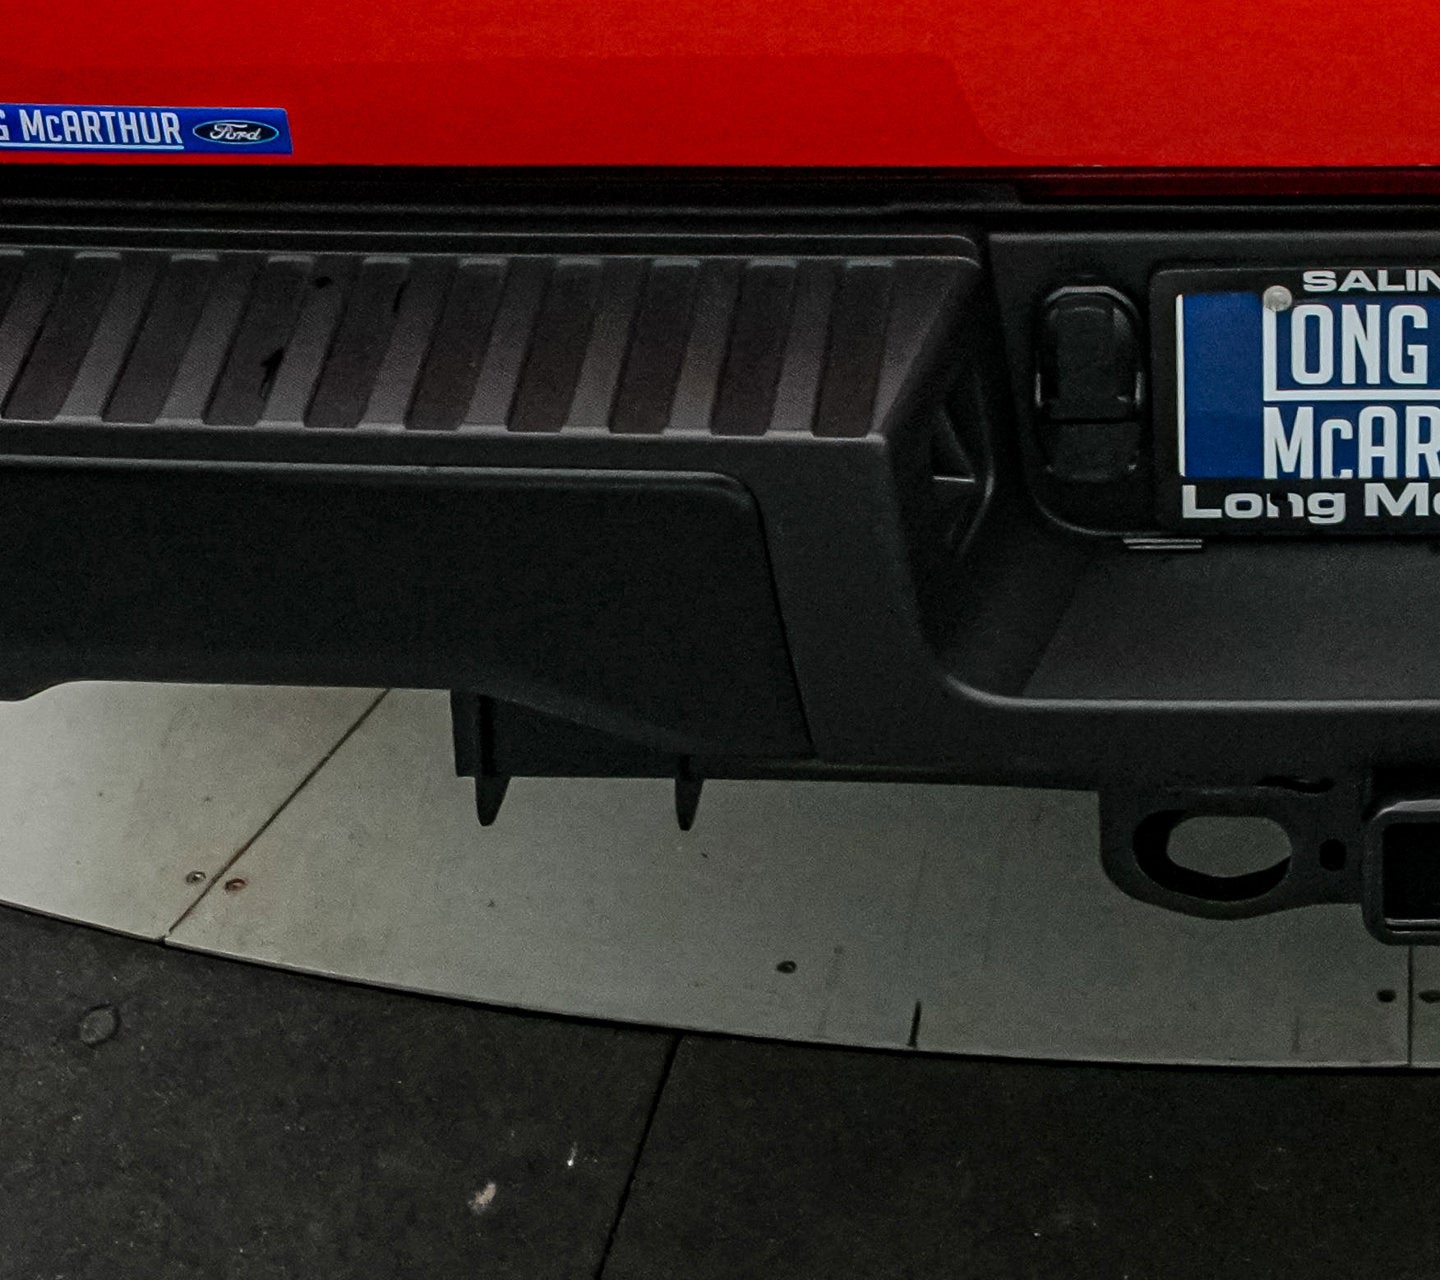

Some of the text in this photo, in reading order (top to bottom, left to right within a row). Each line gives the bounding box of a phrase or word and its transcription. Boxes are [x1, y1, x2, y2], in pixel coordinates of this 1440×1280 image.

[20, 109, 184, 145] McARTHUR
[208, 121, 263, 142] Ford
[1262, 299, 1429, 401] LONG
[1181, 484, 1347, 525] Long
